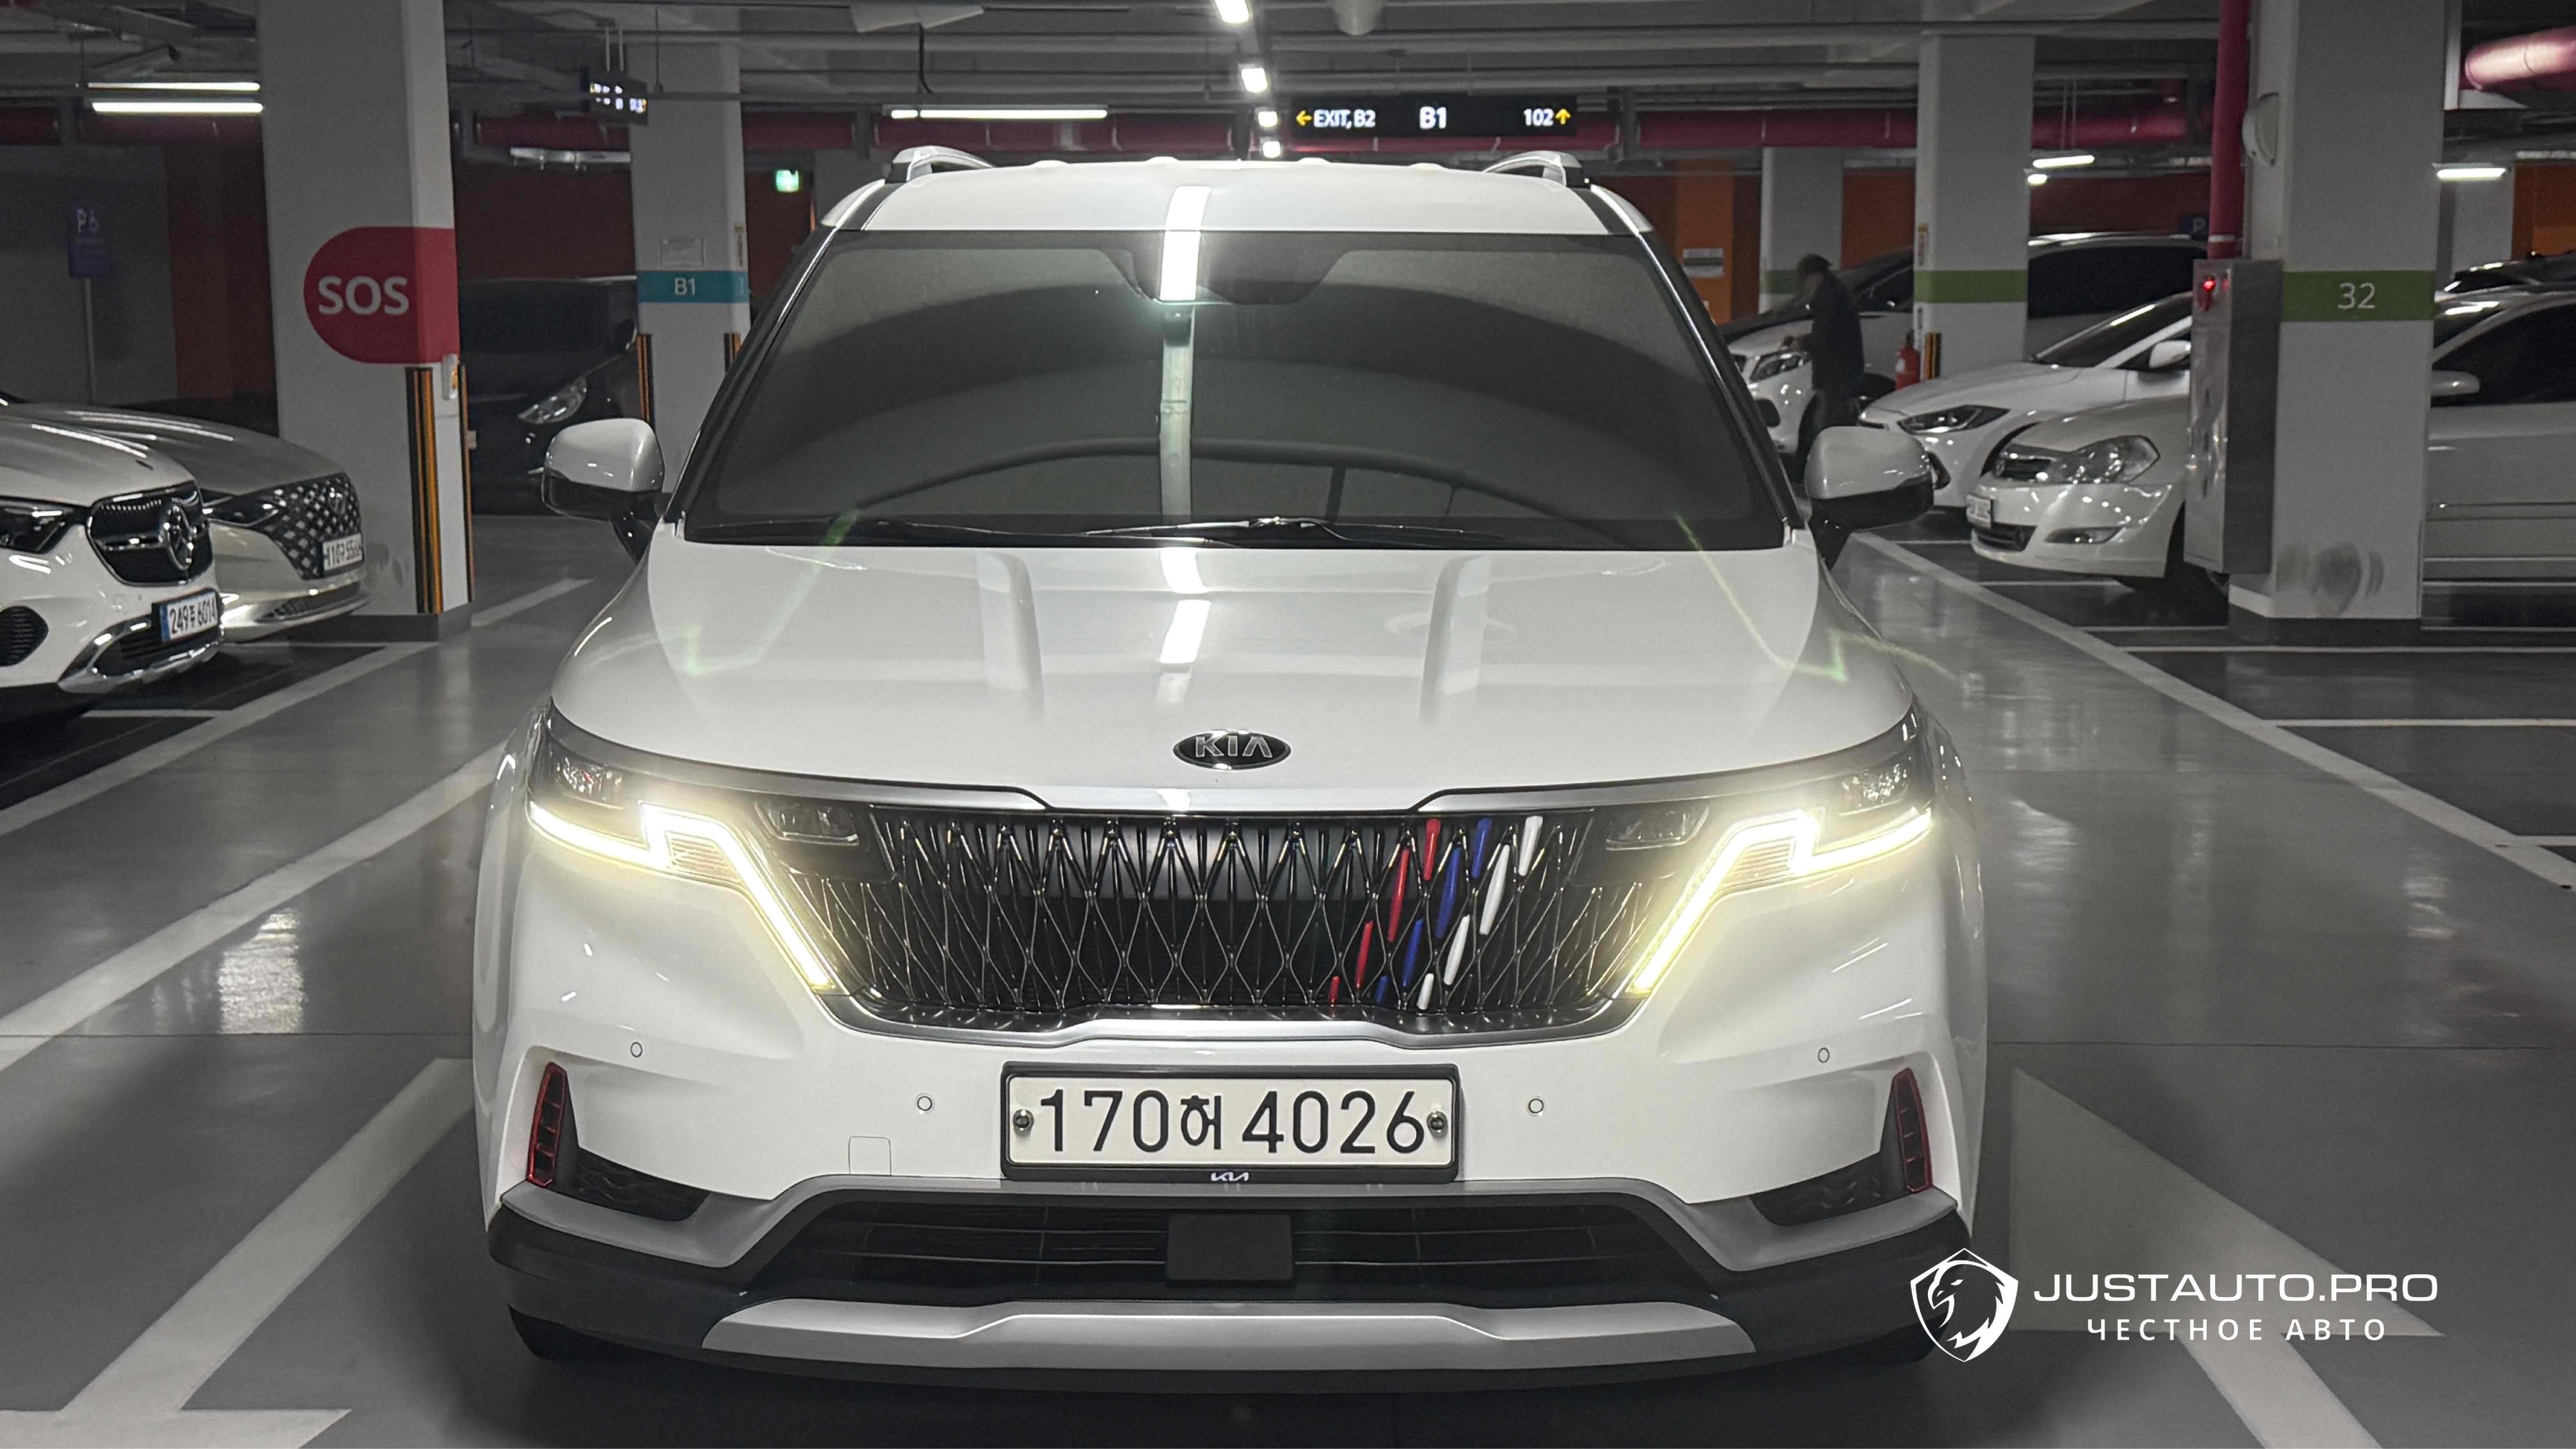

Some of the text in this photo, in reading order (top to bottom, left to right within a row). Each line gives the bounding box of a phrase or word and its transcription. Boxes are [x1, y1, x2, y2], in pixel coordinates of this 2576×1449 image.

[1419, 106, 1447, 129] B1
[1524, 108, 1553, 127] 102
[318, 276, 409, 315] SOS
[674, 277, 696, 296] B1
[2338, 282, 2375, 309] 32
[1195, 735, 1273, 757] KIA
[1242, 1090, 1425, 1154] 4026
